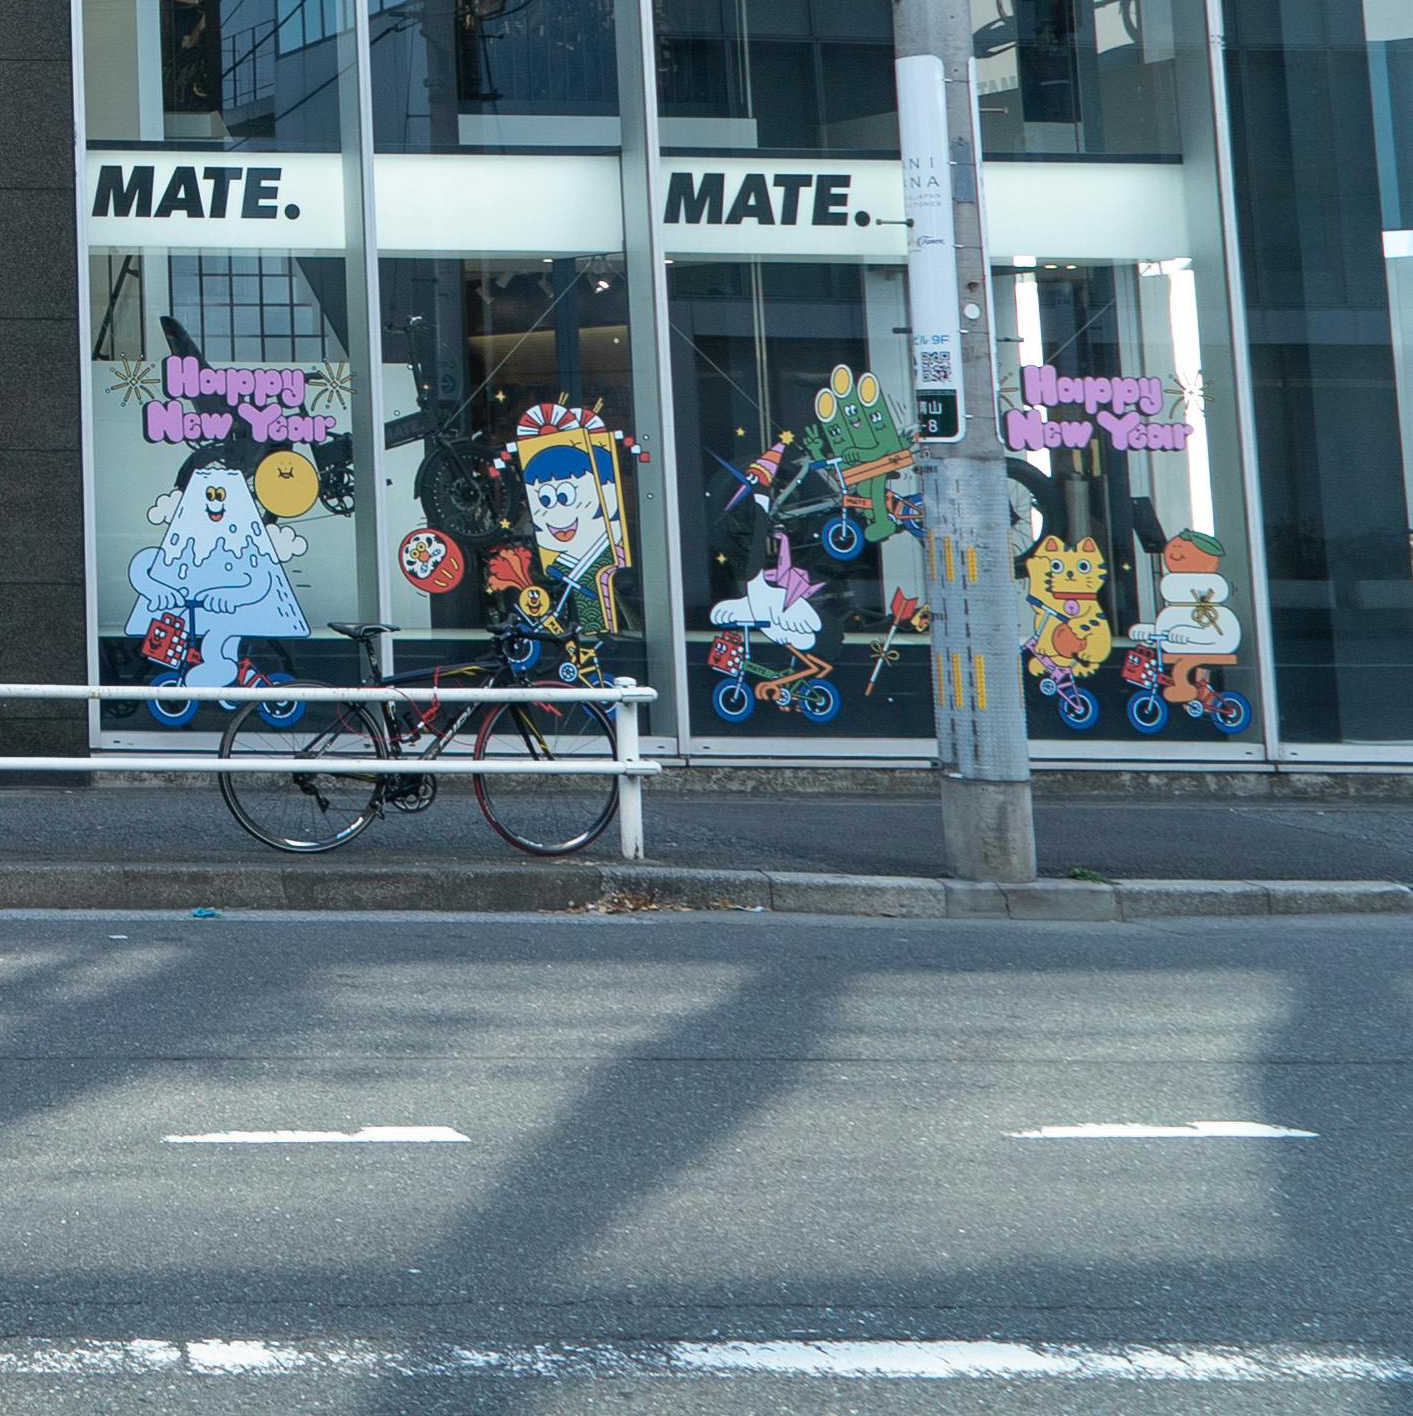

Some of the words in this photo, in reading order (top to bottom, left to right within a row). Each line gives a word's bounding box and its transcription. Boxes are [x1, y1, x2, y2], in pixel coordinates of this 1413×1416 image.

[91, 165, 301, 220] MATE.
[664, 172, 871, 227] MATE.
[162, 354, 305, 408] Happy
[1021, 363, 1163, 417] Happy
[142, 398, 234, 444] New
[236, 401, 337, 444] Year
[1004, 408, 1094, 452] New
[1095, 409, 1195, 452] Year
